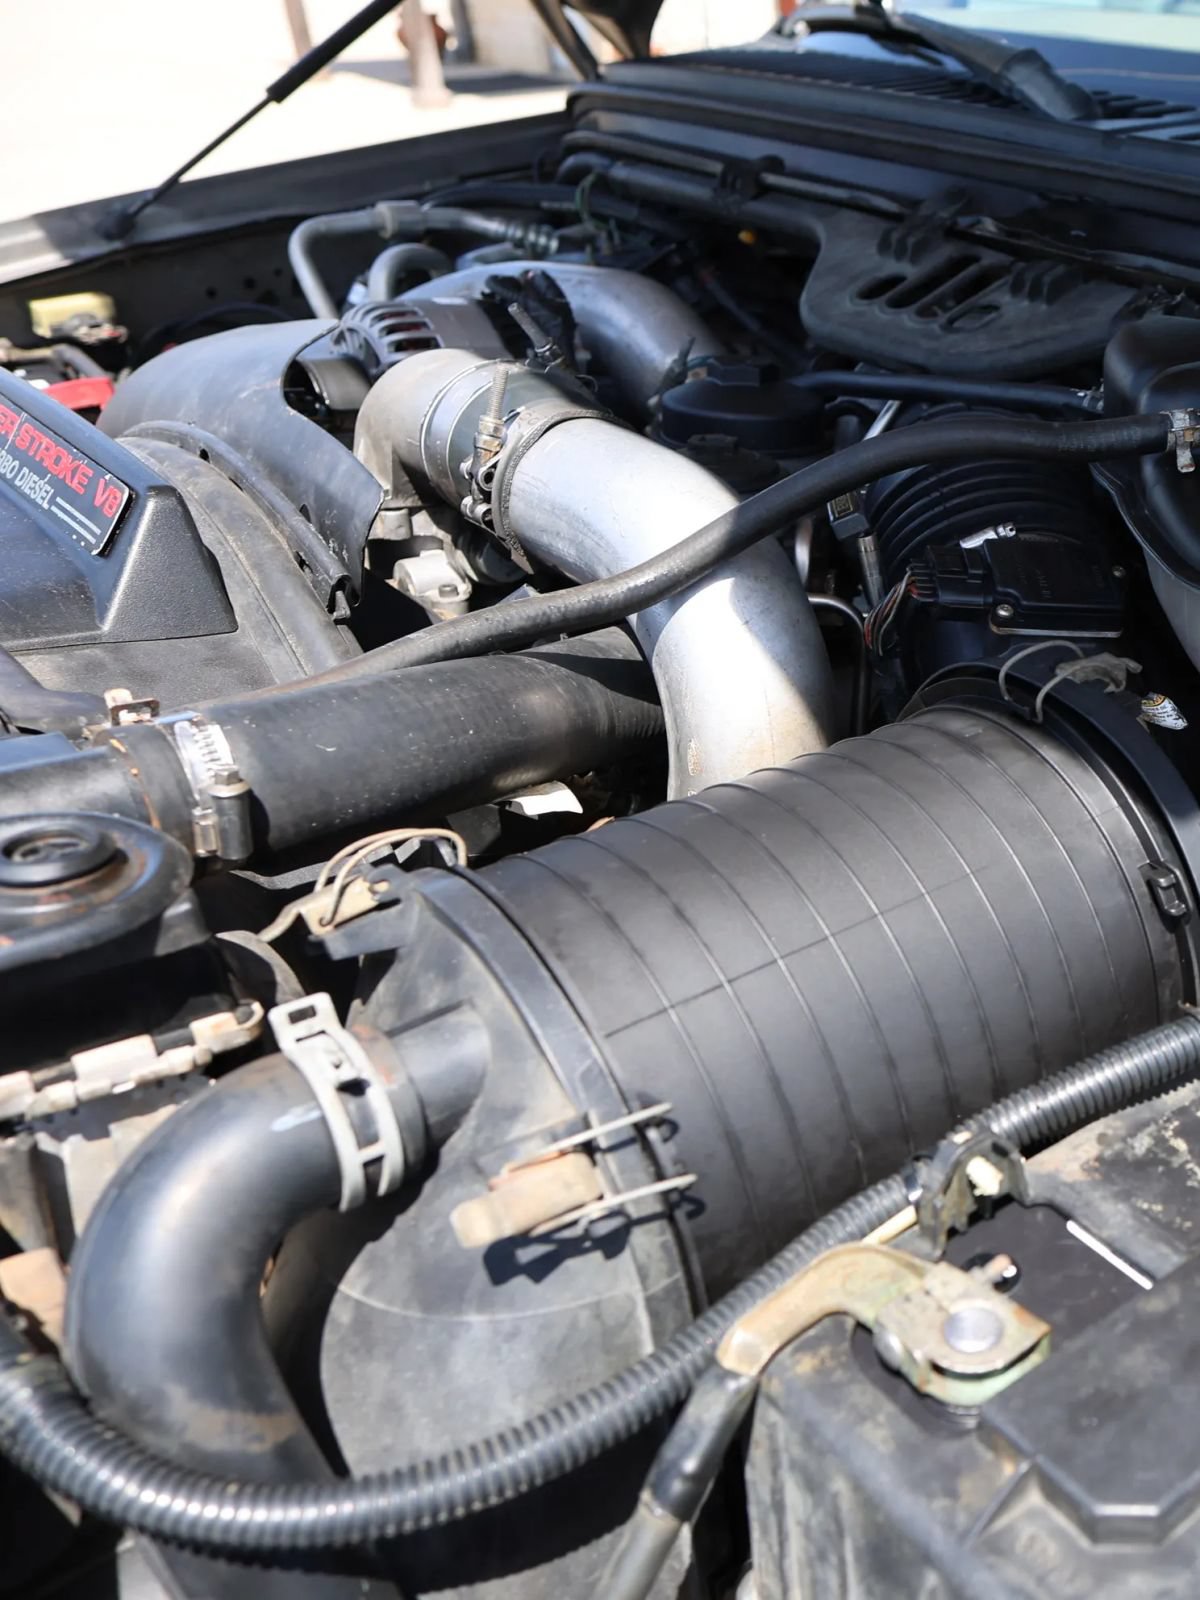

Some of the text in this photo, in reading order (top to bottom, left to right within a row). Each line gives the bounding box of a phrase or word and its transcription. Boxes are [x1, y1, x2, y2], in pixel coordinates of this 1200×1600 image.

[14, 466, 54, 510] DIESEL
[15, 422, 94, 495] STROKE
[94, 478, 122, 517] V8
